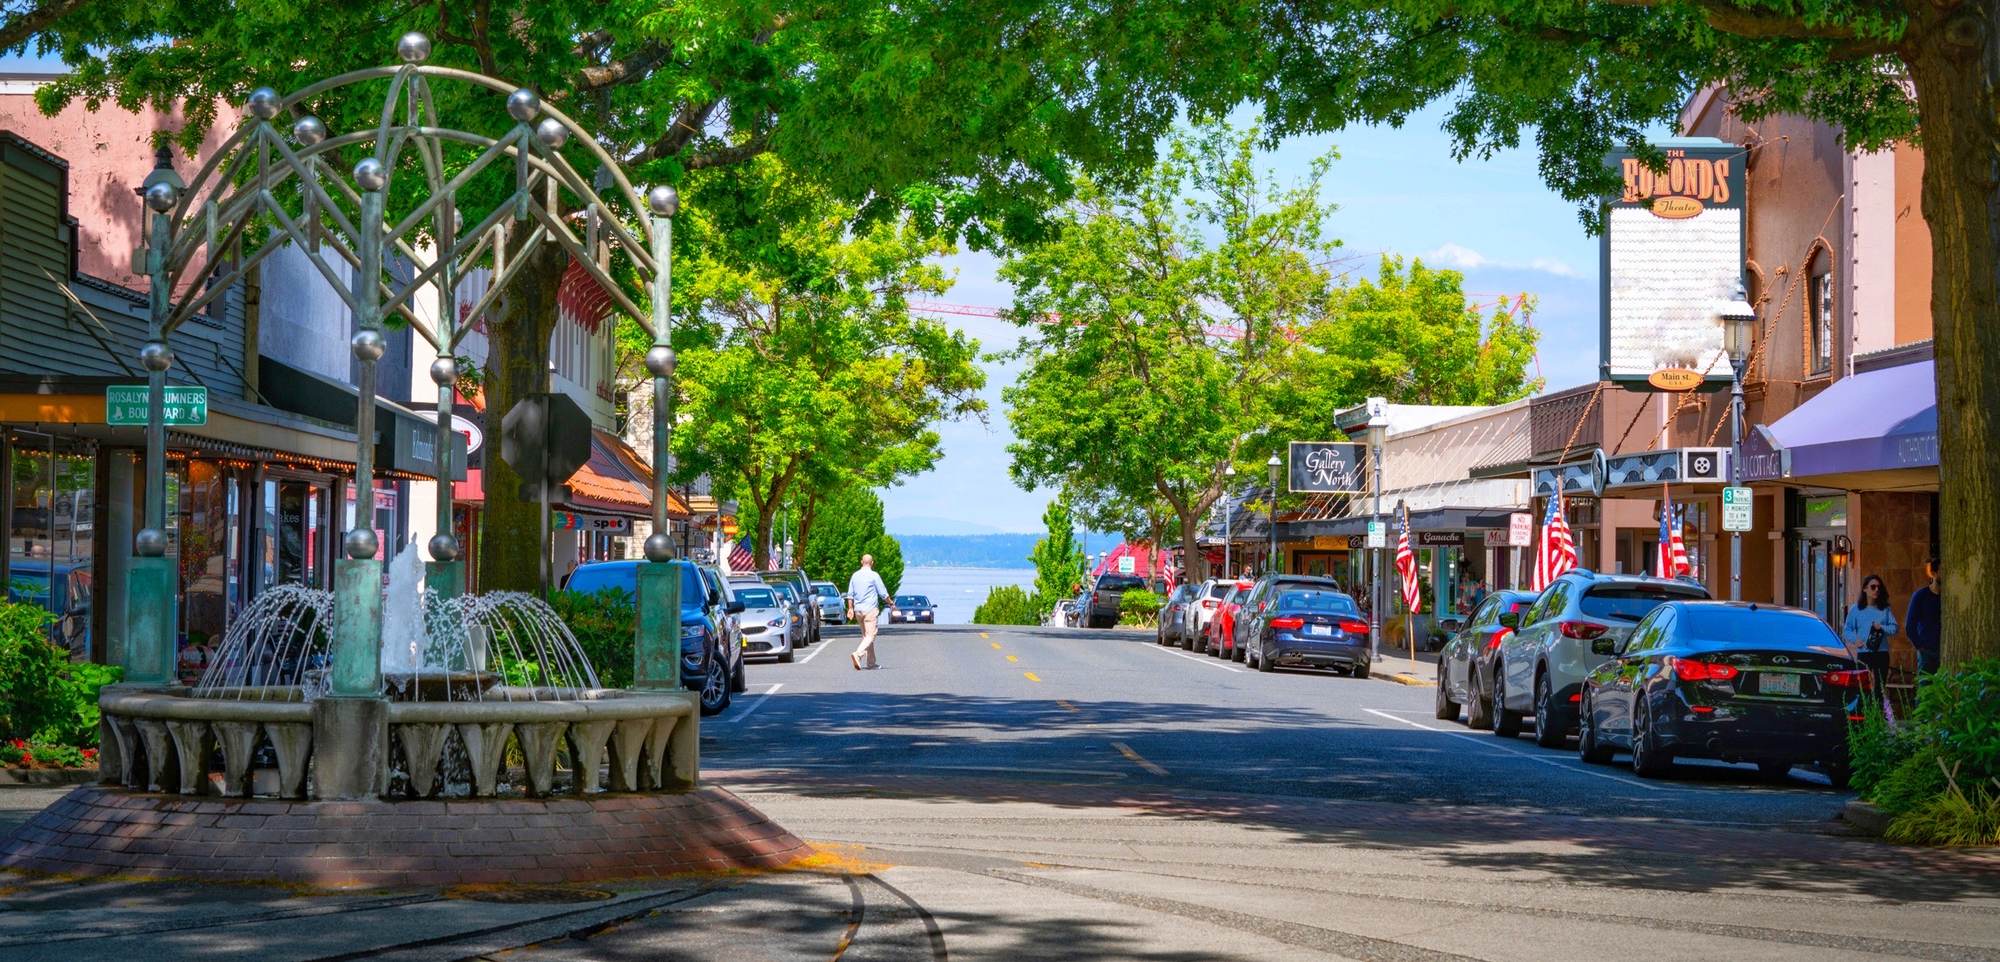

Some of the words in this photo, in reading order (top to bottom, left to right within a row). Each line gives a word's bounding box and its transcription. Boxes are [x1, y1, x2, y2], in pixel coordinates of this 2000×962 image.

[1667, 149, 1685, 157] THE
[1621, 158, 1730, 203] EDMONDS
[1661, 200, 1696, 212] Theater
[1662, 372, 1680, 381] Main
[163, 392, 205, 404] UMNERS
[128, 407, 185, 419] BOUARD
[1306, 448, 1346, 475] Gallery
[1312, 469, 1352, 486] North
[1725, 490, 1732, 501] 3
[593, 519, 623, 529] spot
[1423, 532, 1460, 544] Ganache
